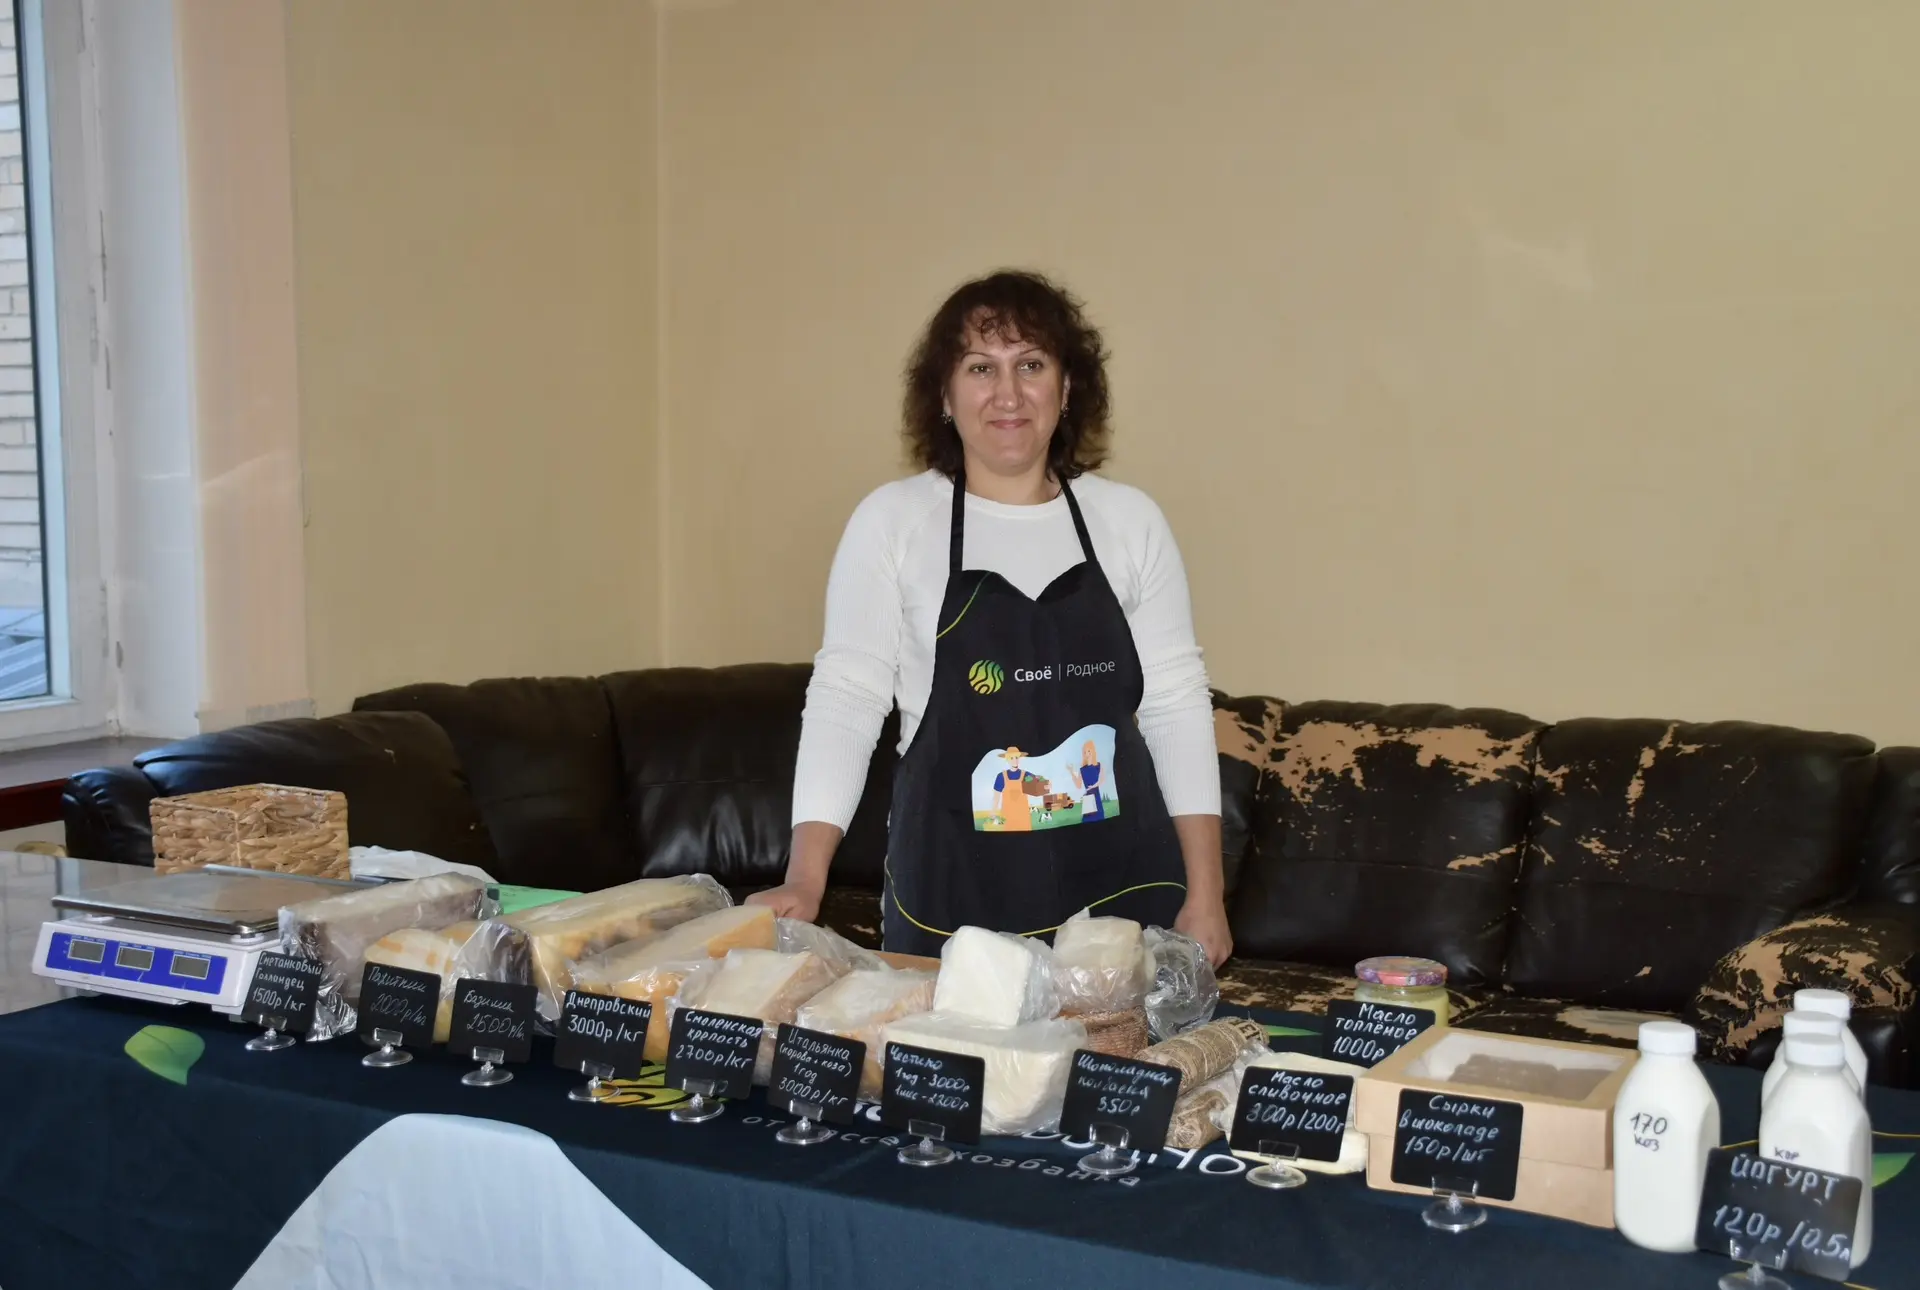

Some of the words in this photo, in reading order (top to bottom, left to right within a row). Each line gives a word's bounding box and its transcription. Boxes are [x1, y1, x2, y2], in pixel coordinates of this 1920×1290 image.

[1014, 665, 1053, 682] Своё
[1066, 660, 1116, 677] Родное
[259, 952, 323, 975] Сметанковый
[255, 968, 305, 991] Голландец
[566, 991, 652, 1018] Днепровский
[1358, 1003, 1416, 1025] Масло
[685, 1011, 763, 1038] Смоленская
[1335, 1017, 1417, 1040] топлёное
[687, 1028, 748, 1048] крепость
[788, 1028, 850, 1060] Итальянка
[1077, 1054, 1173, 1086] Шоколадная
[1270, 1071, 1324, 1088] Масло
[1248, 1084, 1347, 1105] сливочное
[1428, 1095, 1496, 1119] Сырки
[742, 1116, 786, 1127] от
[1630, 1112, 1667, 1134] 170
